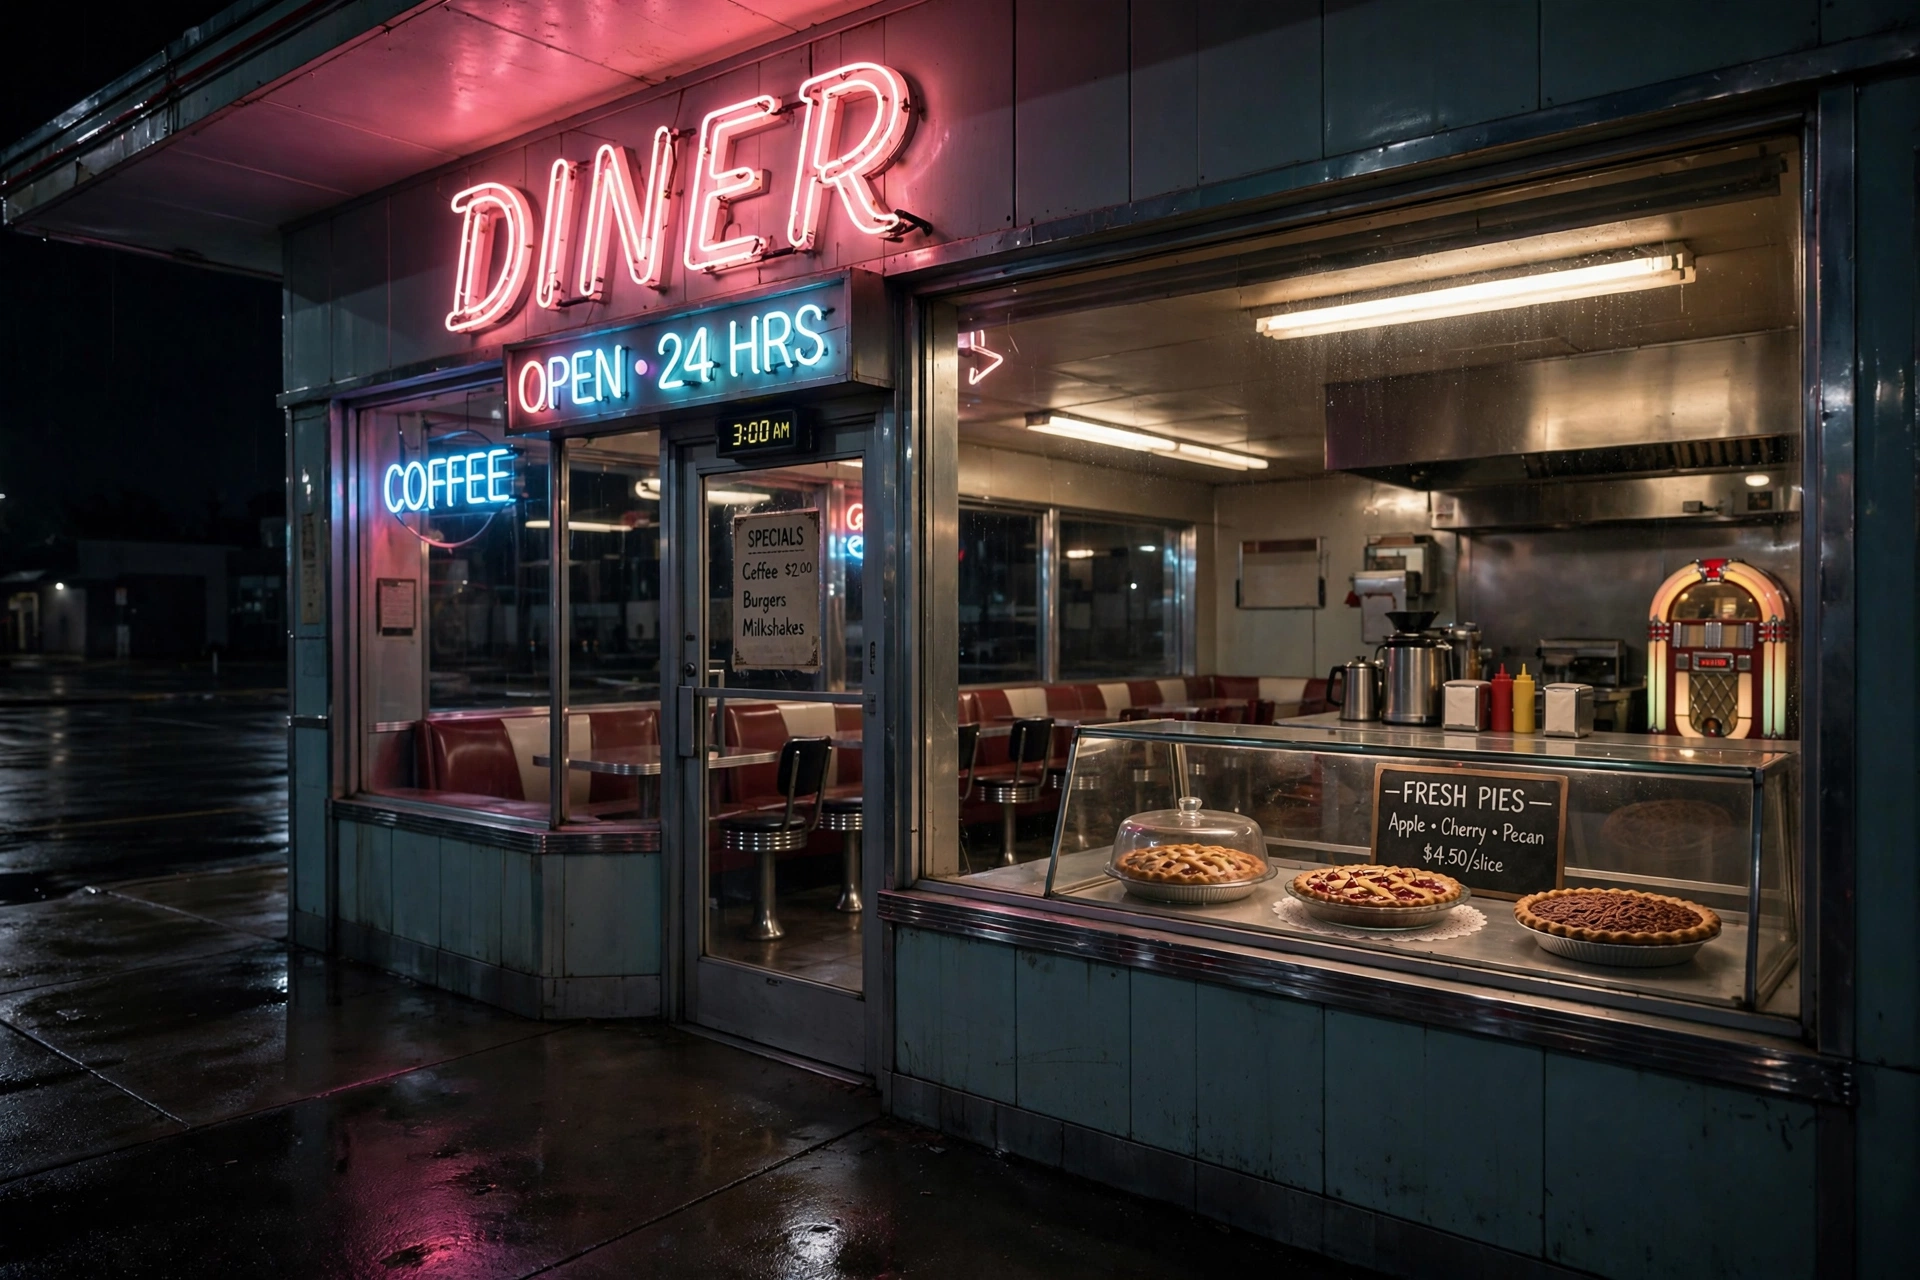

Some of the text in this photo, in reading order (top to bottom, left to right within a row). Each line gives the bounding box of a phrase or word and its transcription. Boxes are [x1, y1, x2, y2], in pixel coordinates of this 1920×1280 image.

[446, 61, 908, 332] DINER
[518, 304, 825, 414] OPEN 24 HRS
[732, 419, 790, 446] 3:00 AM
[384, 448, 511, 514] COFFEE
[748, 525, 804, 548] SPECIALS
[743, 590, 787, 614] Burgers
[742, 616, 805, 637] Milkshakes
[1403, 780, 1525, 813] FRESH PIES
[1388, 811, 1545, 846] Apple Cherry Pecan
[1422, 842, 1504, 873] $4.50/slice
